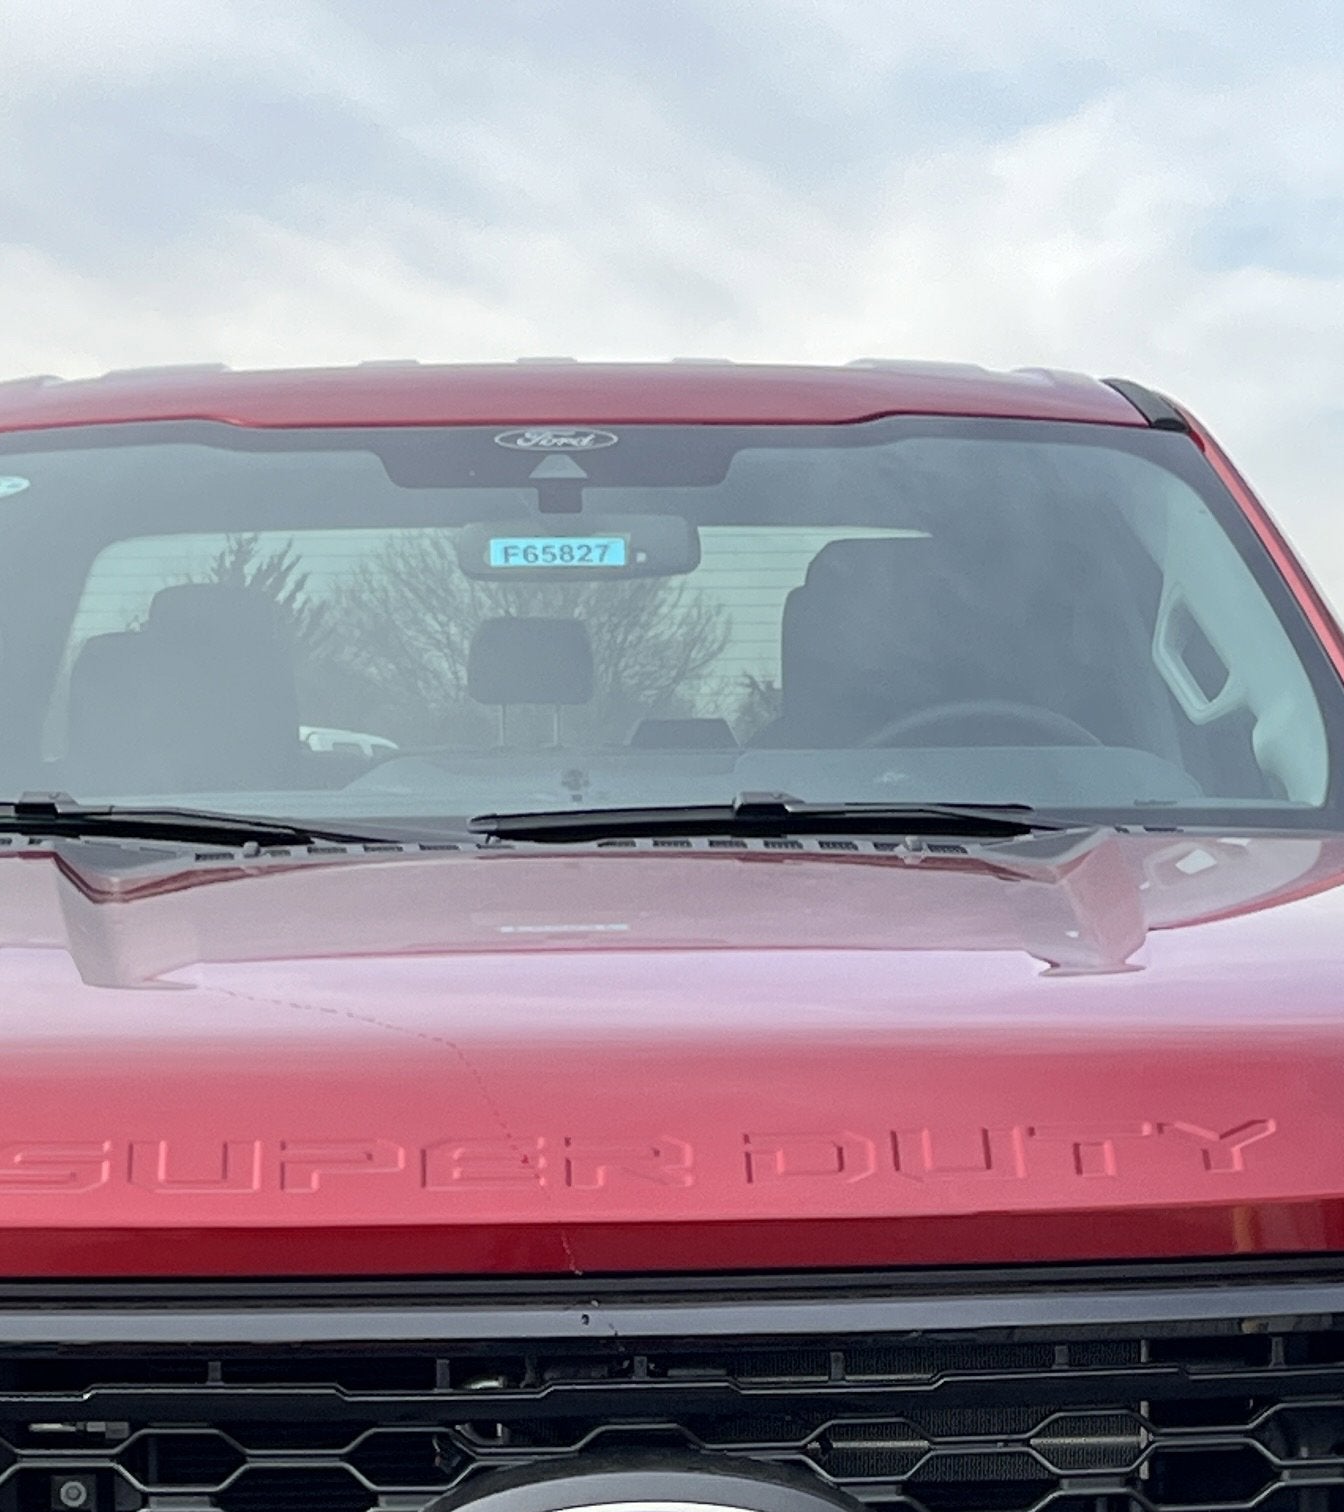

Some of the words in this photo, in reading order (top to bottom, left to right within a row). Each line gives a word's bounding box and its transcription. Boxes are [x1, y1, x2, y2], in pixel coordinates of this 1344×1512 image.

[517, 429, 595, 447] Ford
[503, 544, 610, 564] F65827
[743, 1118, 1277, 1184] DUTY
